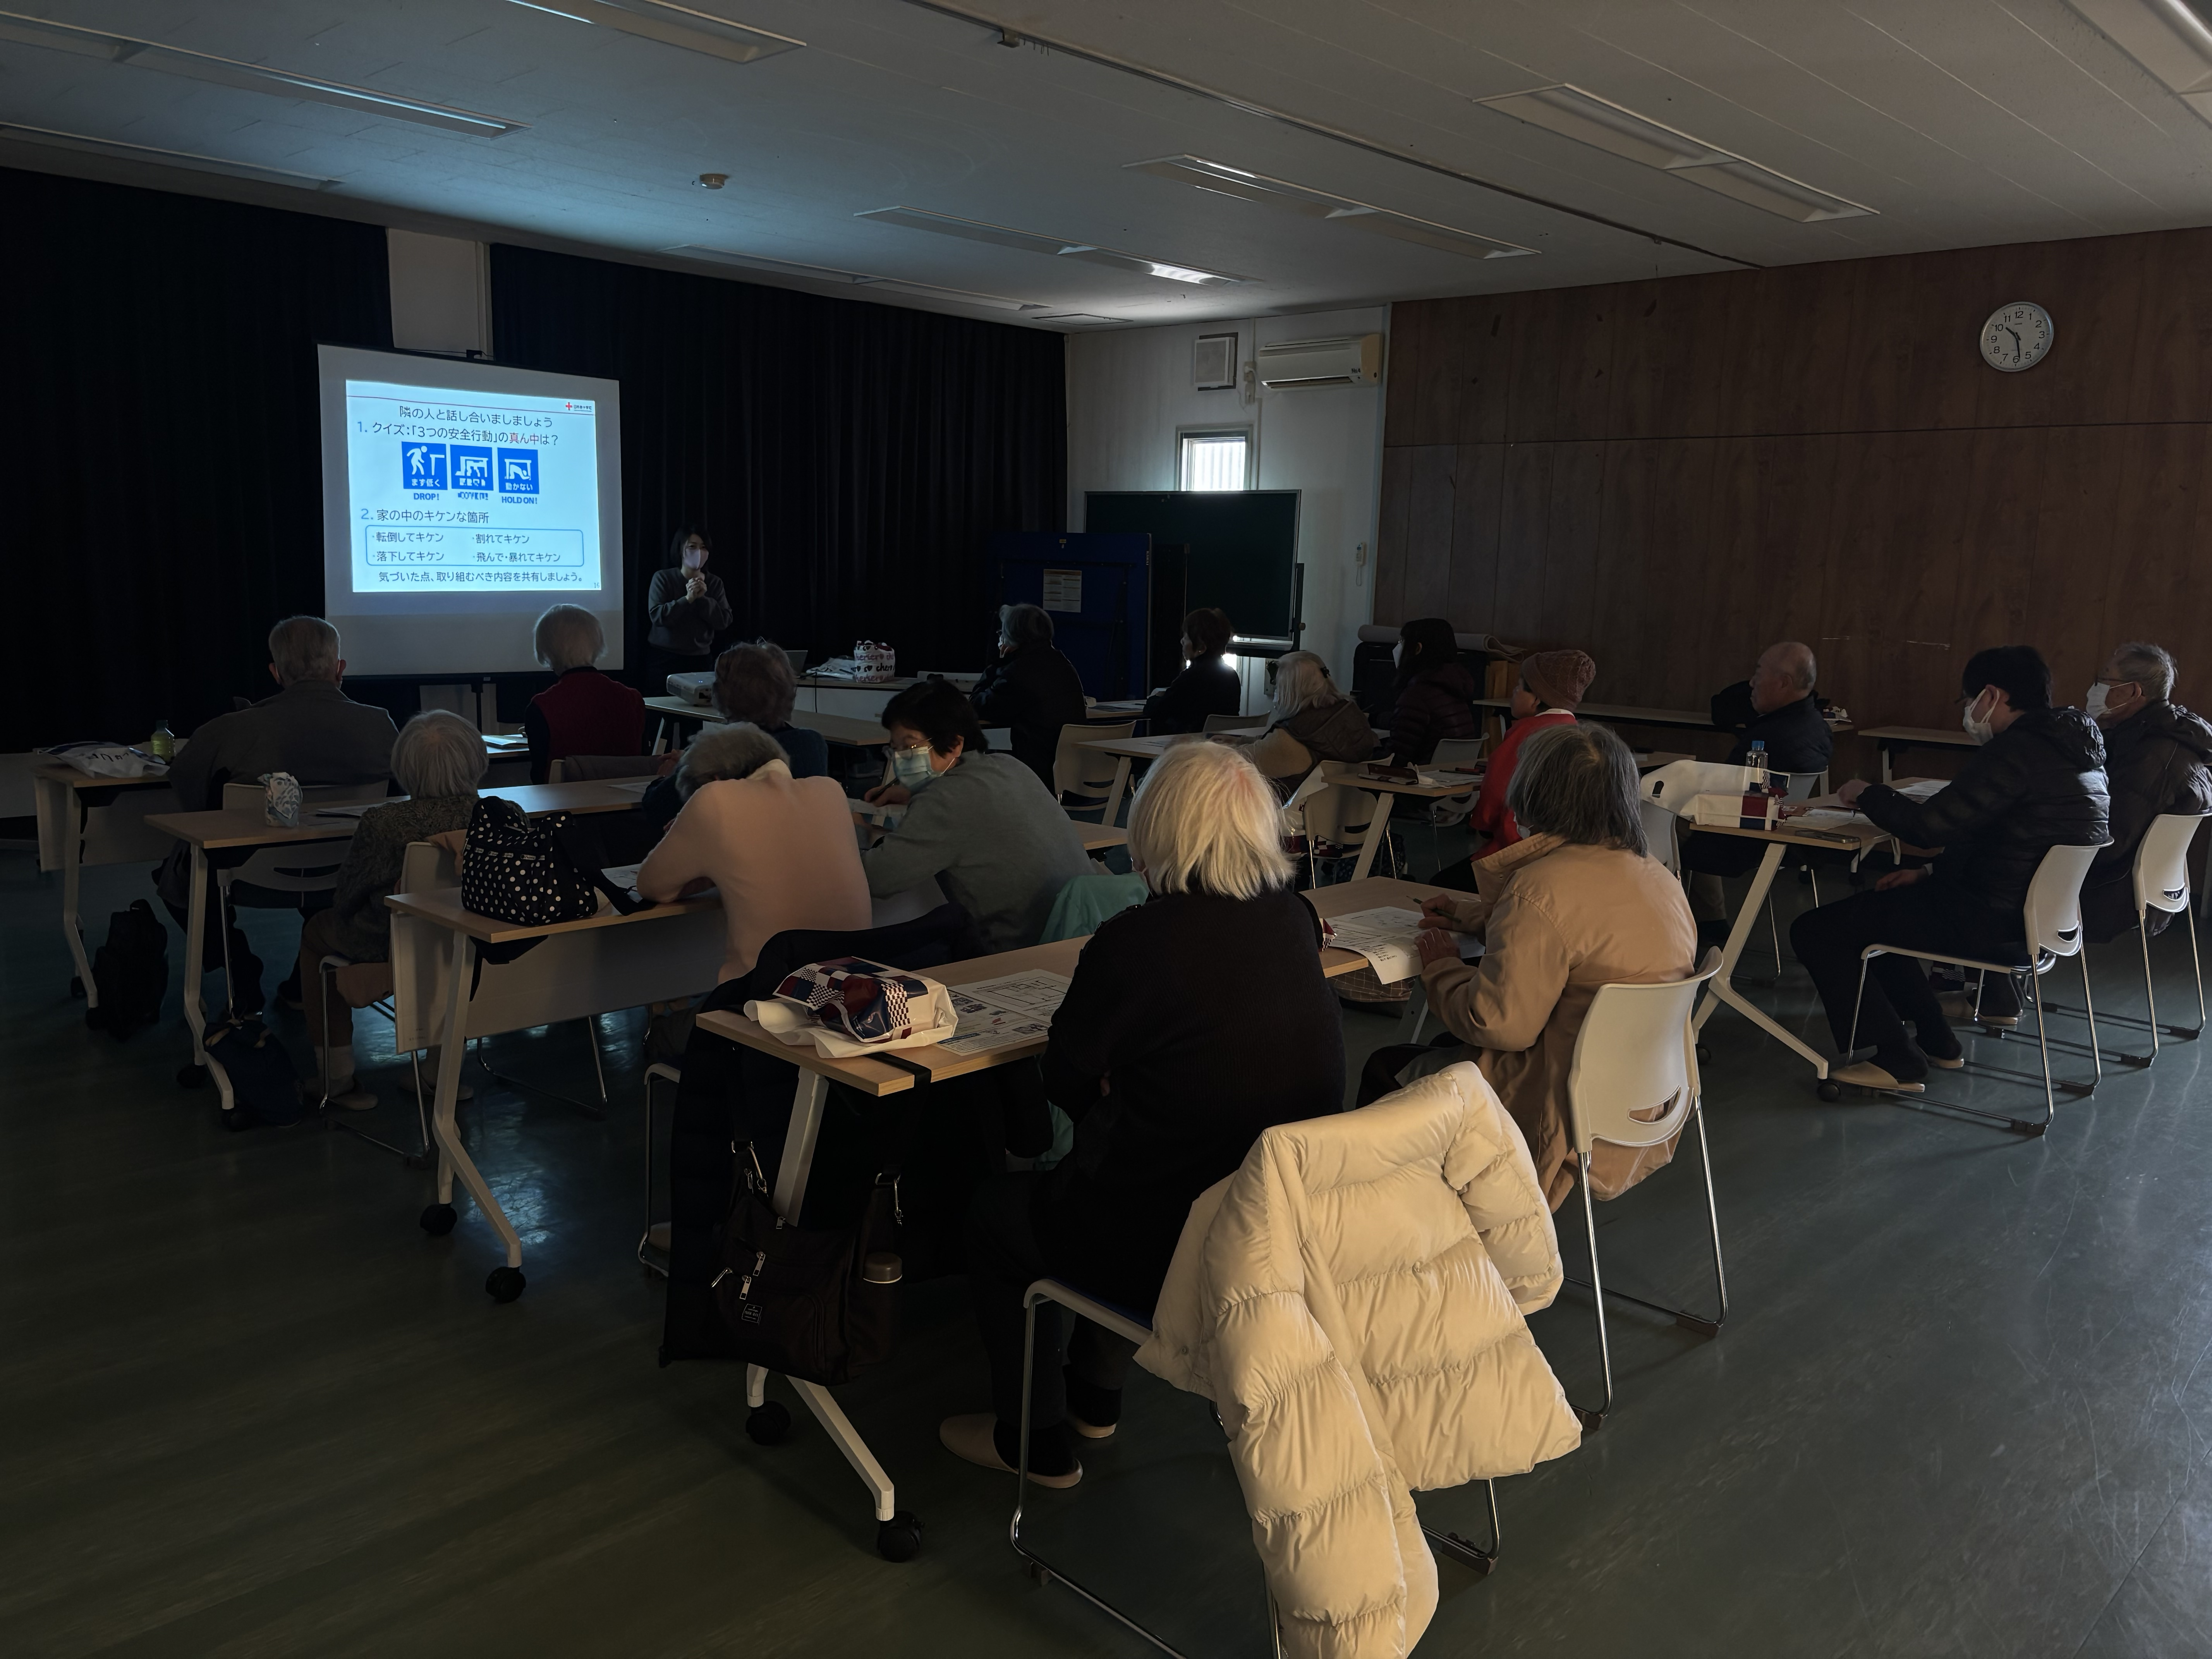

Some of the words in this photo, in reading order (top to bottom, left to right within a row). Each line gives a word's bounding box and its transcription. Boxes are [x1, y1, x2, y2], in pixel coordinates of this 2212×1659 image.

[400, 405, 552, 428] 隣の人と話し合いましましょう
[357, 421, 368, 433] 1.
[361, 508, 373, 520] 2.
[377, 509, 489, 524] 家の中のキケンな箇所
